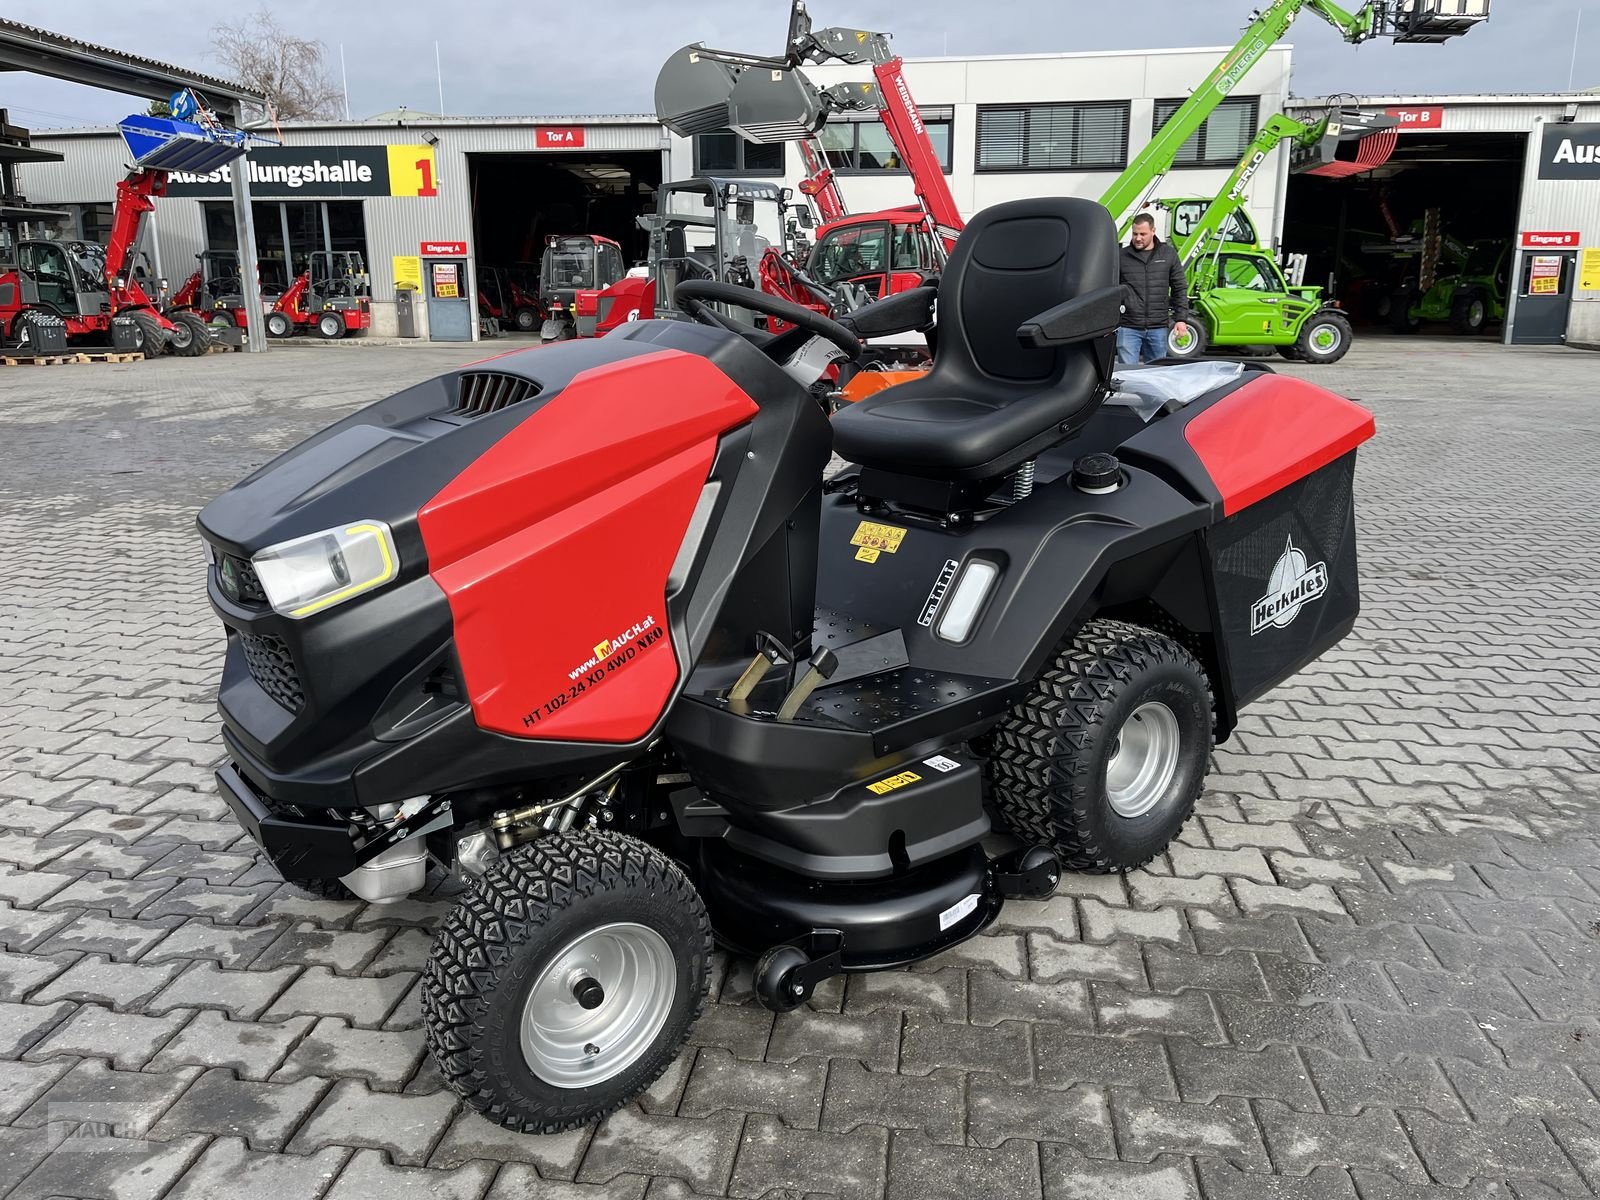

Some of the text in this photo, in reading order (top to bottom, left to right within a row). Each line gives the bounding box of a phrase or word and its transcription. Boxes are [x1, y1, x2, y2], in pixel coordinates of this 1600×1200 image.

[1230, 40, 1265, 77] MERLO
[895, 74, 924, 135] WEIDEMANN
[1397, 111, 1430, 122] Tor B
[546, 131, 574, 142] Tor A
[167, 159, 438, 197] Ausstllungshalle 1
[1227, 151, 1265, 201] MERLO
[426, 244, 460, 253] Eingang A
[1529, 234, 1572, 244] Eingang B
[1255, 574, 1324, 626] Herkules
[568, 615, 655, 680] www.MAUCH.at
[522, 626, 664, 728] HT 102-24 XD 4WD NEO
